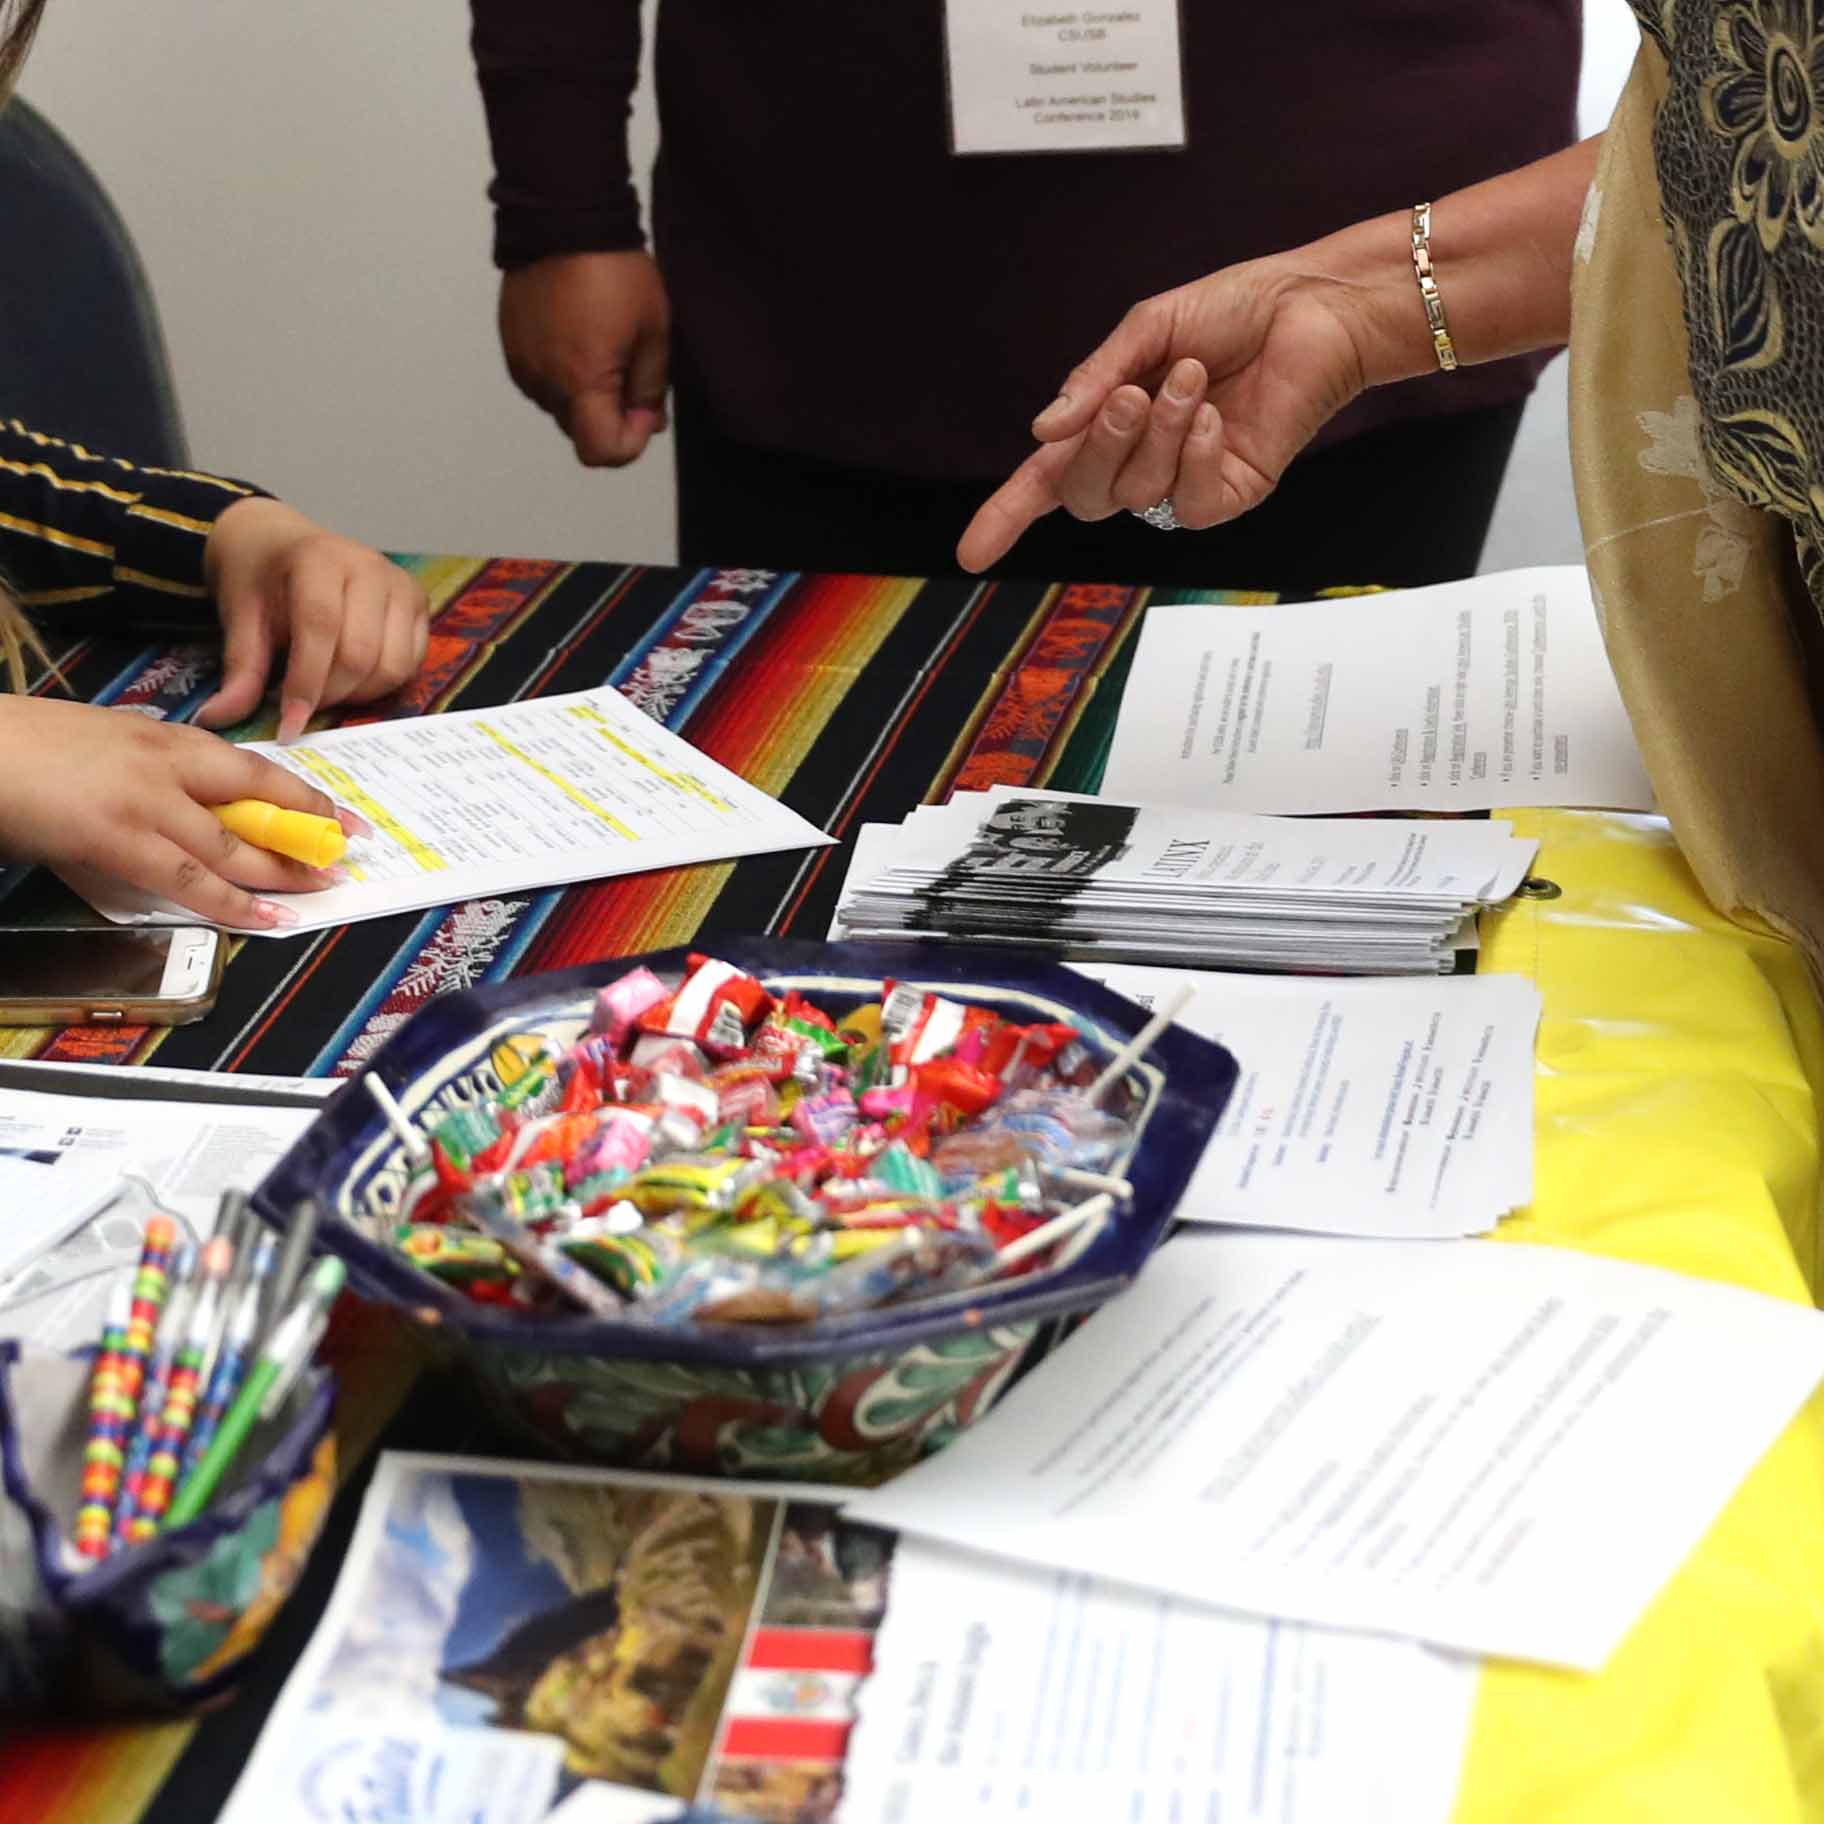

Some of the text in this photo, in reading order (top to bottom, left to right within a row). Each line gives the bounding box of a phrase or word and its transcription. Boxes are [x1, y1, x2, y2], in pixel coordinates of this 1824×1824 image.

[1029, 62, 1138, 74] Student Volunteer
[1016, 93, 1156, 109] Latin American Studies
[1034, 113, 1104, 124] Conference
[1141, 839, 1210, 878] LATINX
